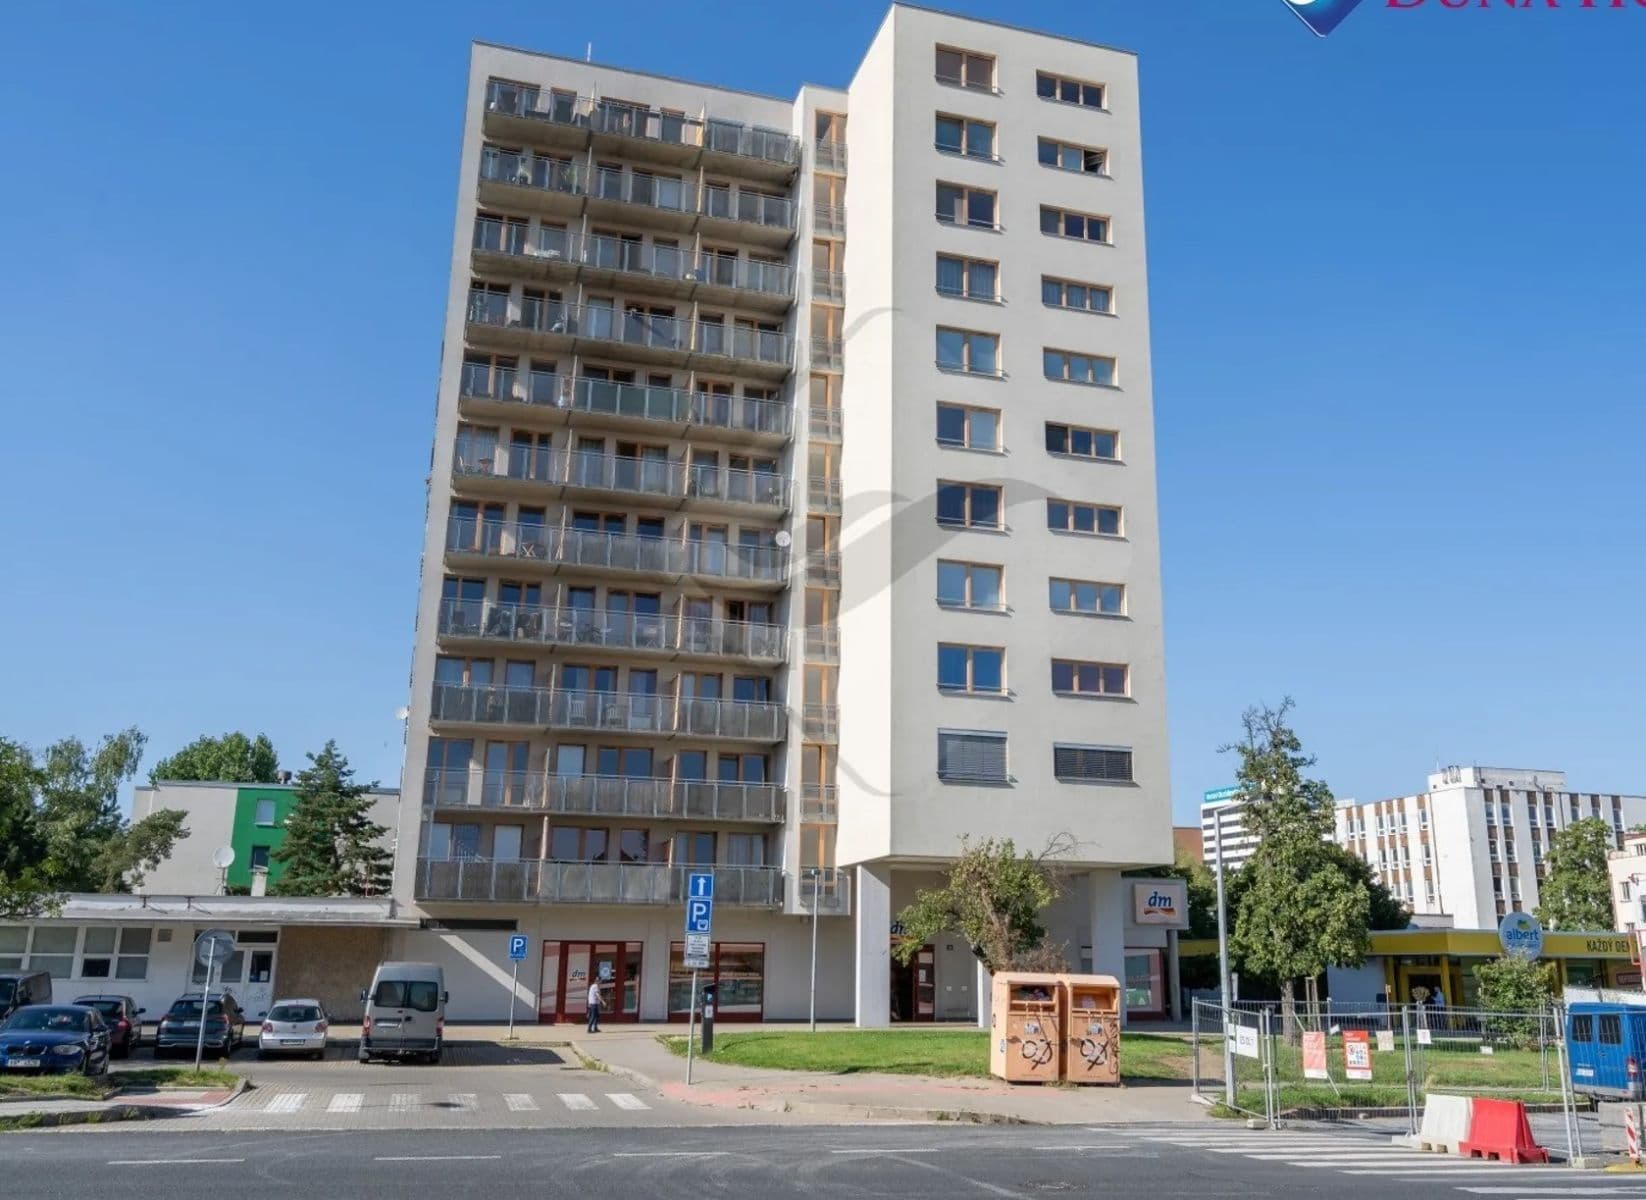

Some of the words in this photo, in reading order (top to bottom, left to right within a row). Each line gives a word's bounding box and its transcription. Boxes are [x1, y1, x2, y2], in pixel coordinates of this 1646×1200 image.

[1148, 890, 1172, 907] dm
[692, 902, 707, 923] P
[1506, 928, 1539, 941] albert
[513, 938, 524, 953] P
[571, 969, 586, 978] dm
